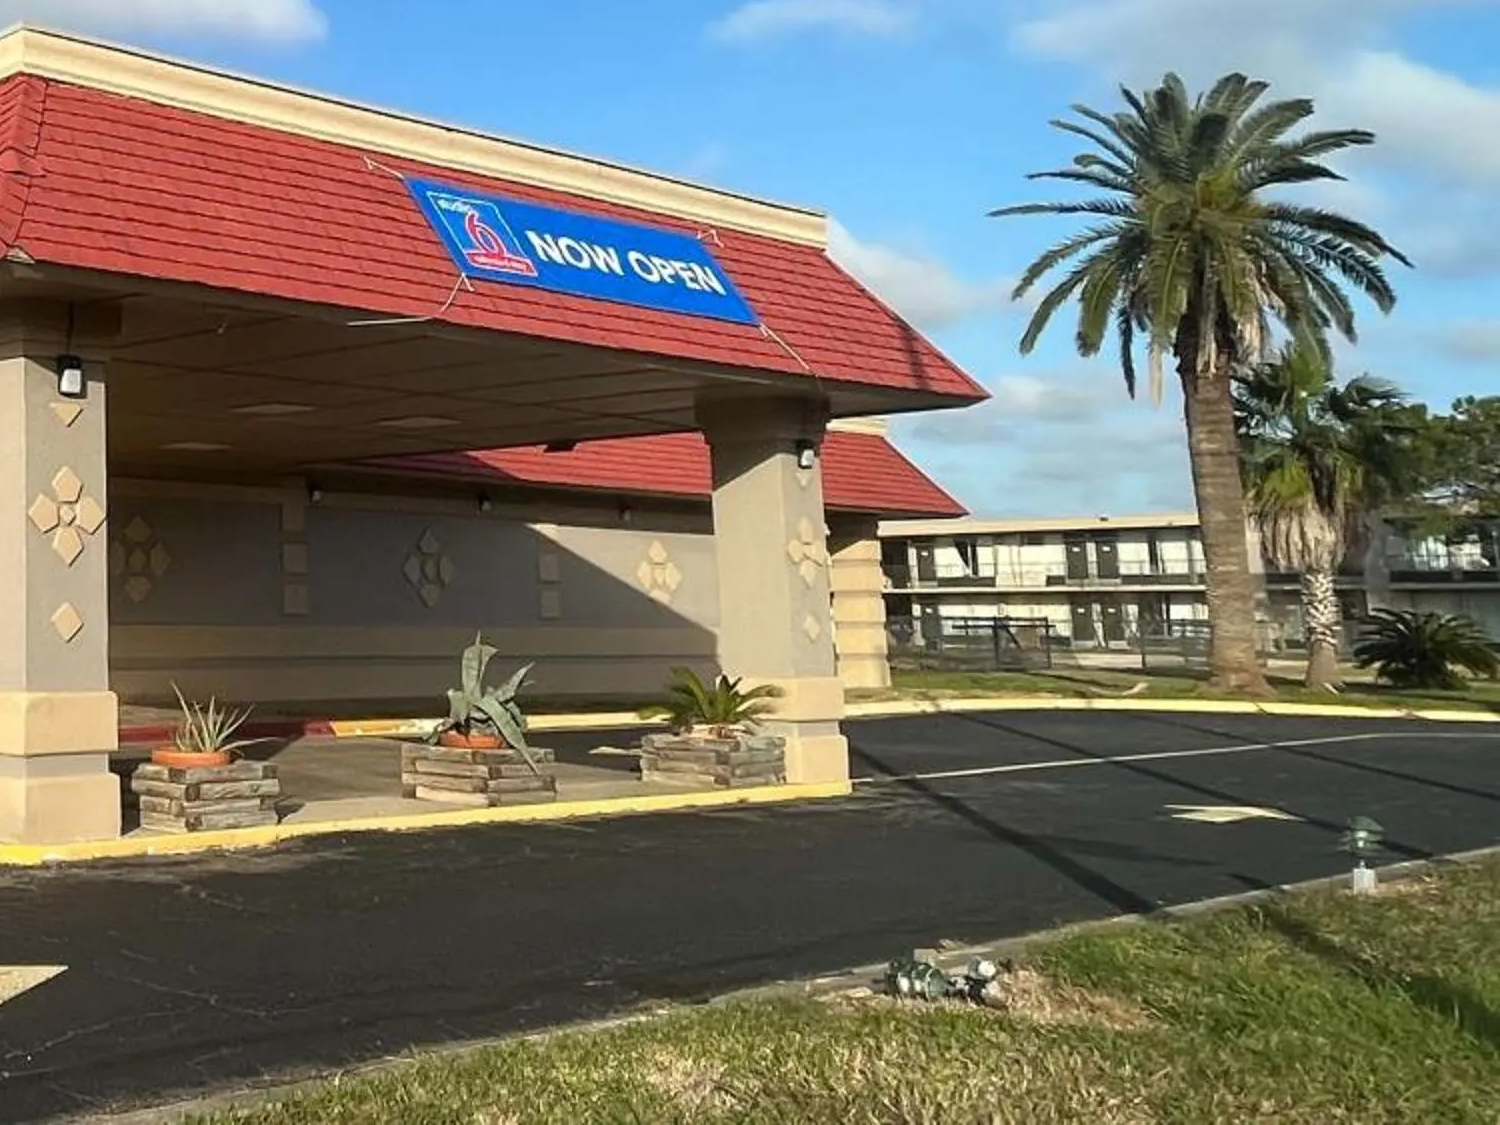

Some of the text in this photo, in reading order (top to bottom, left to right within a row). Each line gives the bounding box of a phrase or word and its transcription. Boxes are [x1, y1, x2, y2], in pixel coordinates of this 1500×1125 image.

[465, 210, 506, 259] 6
[524, 230, 727, 296] NOW OPEN
